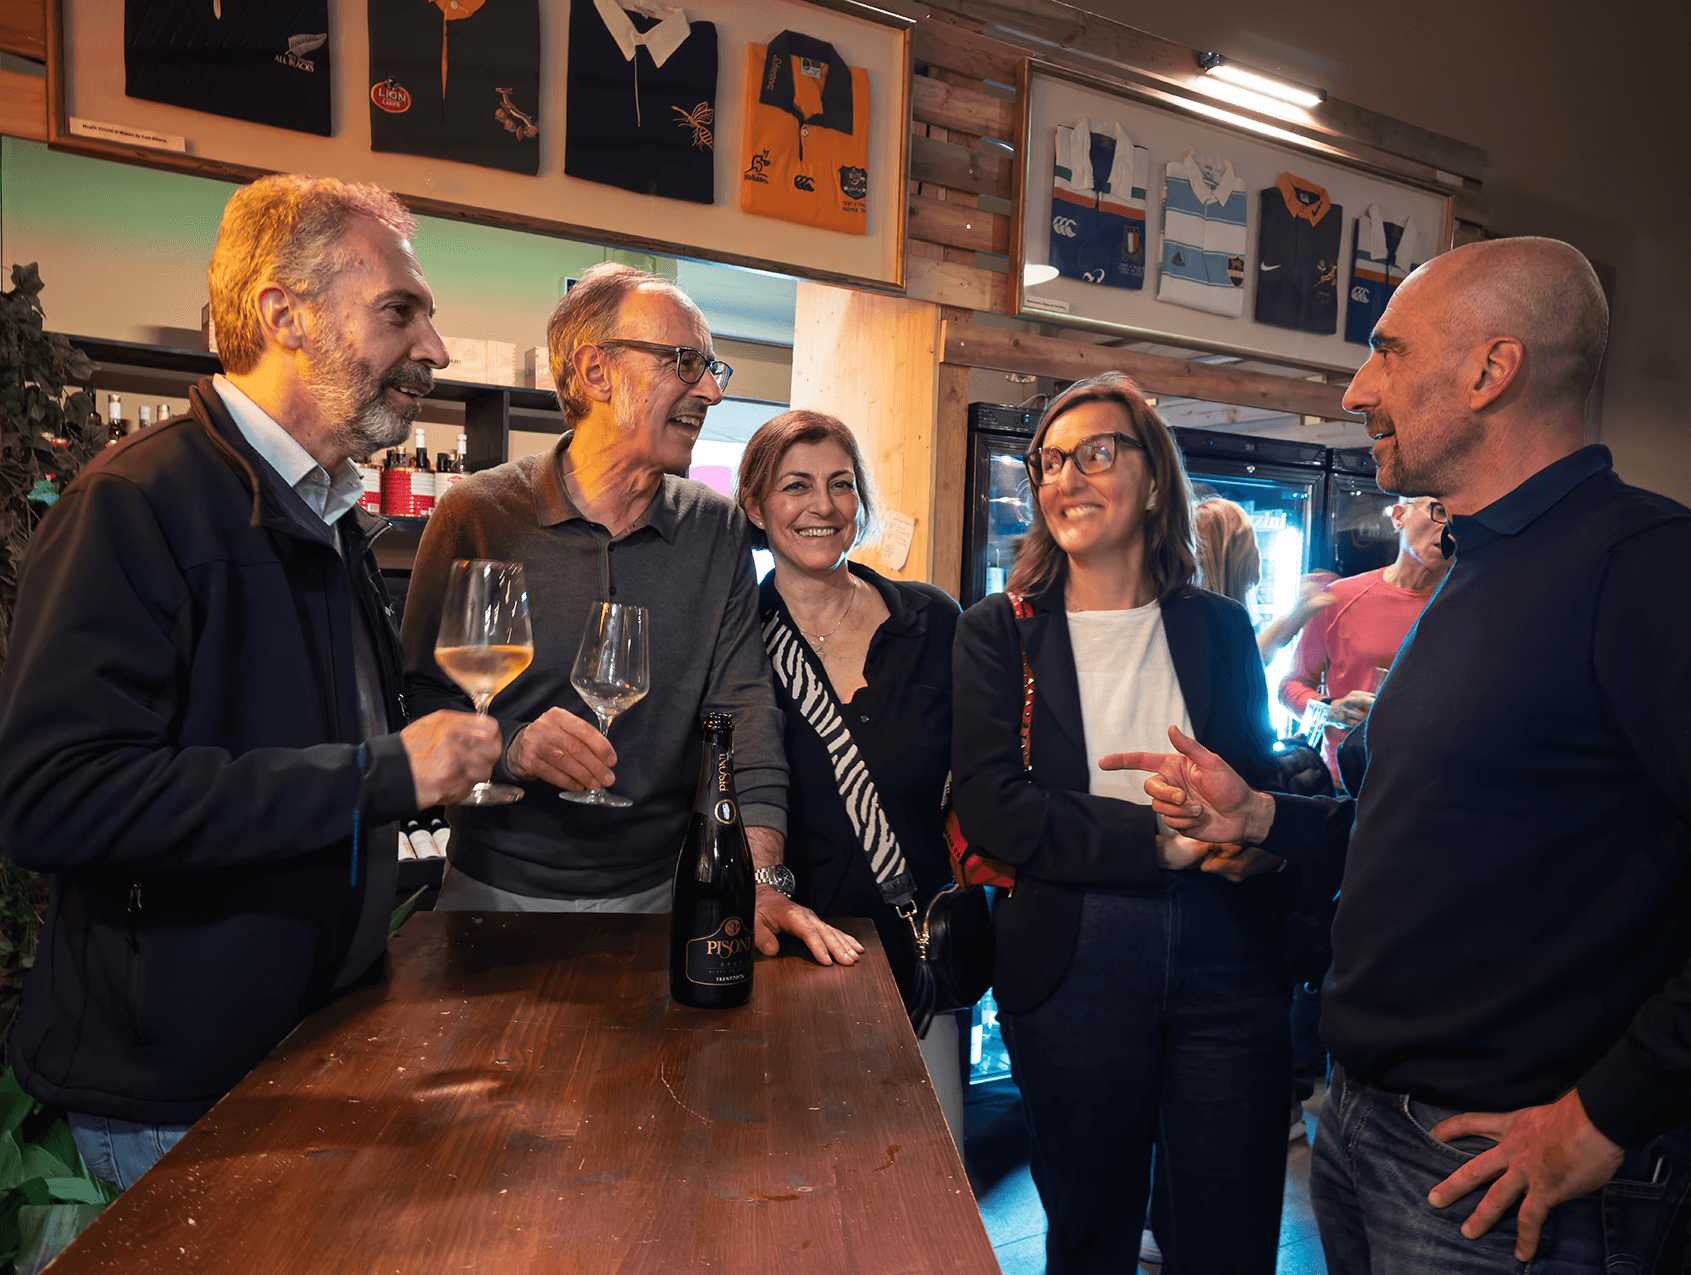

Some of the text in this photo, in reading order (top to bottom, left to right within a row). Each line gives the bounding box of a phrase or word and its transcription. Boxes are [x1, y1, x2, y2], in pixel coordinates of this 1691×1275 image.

[274, 54, 287, 65] ALL
[288, 58, 315, 73] BLACKS
[377, 87, 407, 103] LION
[706, 936, 751, 959] PISONI
